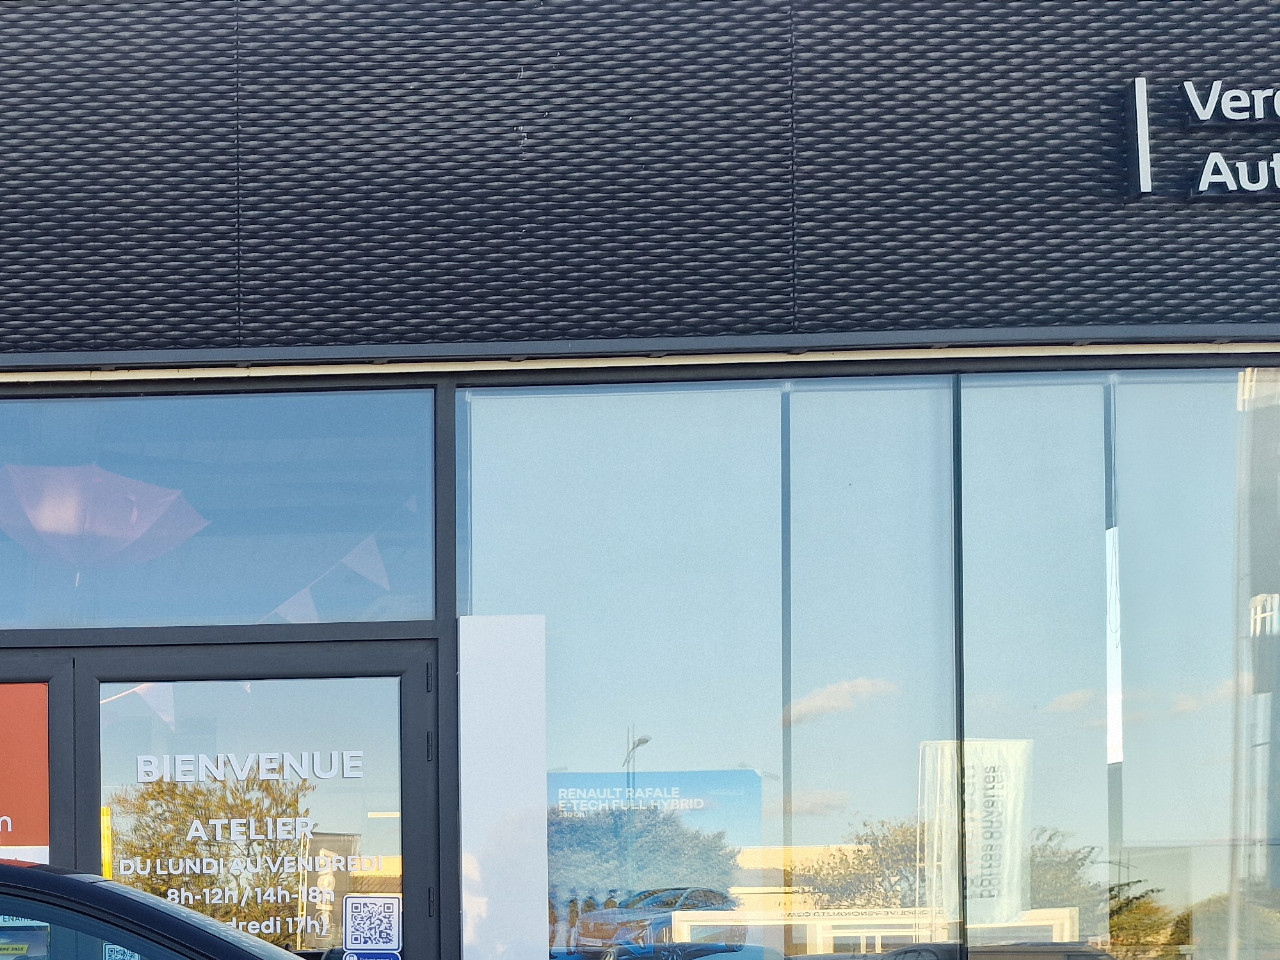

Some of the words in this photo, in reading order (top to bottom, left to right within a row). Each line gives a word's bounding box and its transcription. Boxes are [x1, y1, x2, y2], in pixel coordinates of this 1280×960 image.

[1183, 80, 1280, 121] Ver
[137, 751, 364, 784] BIENVENUE
[558, 787, 622, 799] RENAULT
[625, 786, 680, 799] RAFALE
[558, 800, 609, 811] E-TECH
[612, 800, 647, 810] FULL
[651, 799, 704, 810] HYBRID
[186, 818, 315, 842] ATELIER
[120, 857, 151, 876] DU
[156, 857, 224, 876] LUNDI
[230, 856, 262, 874] AU
[266, 854, 383, 874] VENDREDI
[166, 888, 238, 905] 8h-12h
[255, 886, 335, 905] 14h-18h
[286, 915, 328, 936] 17h)
